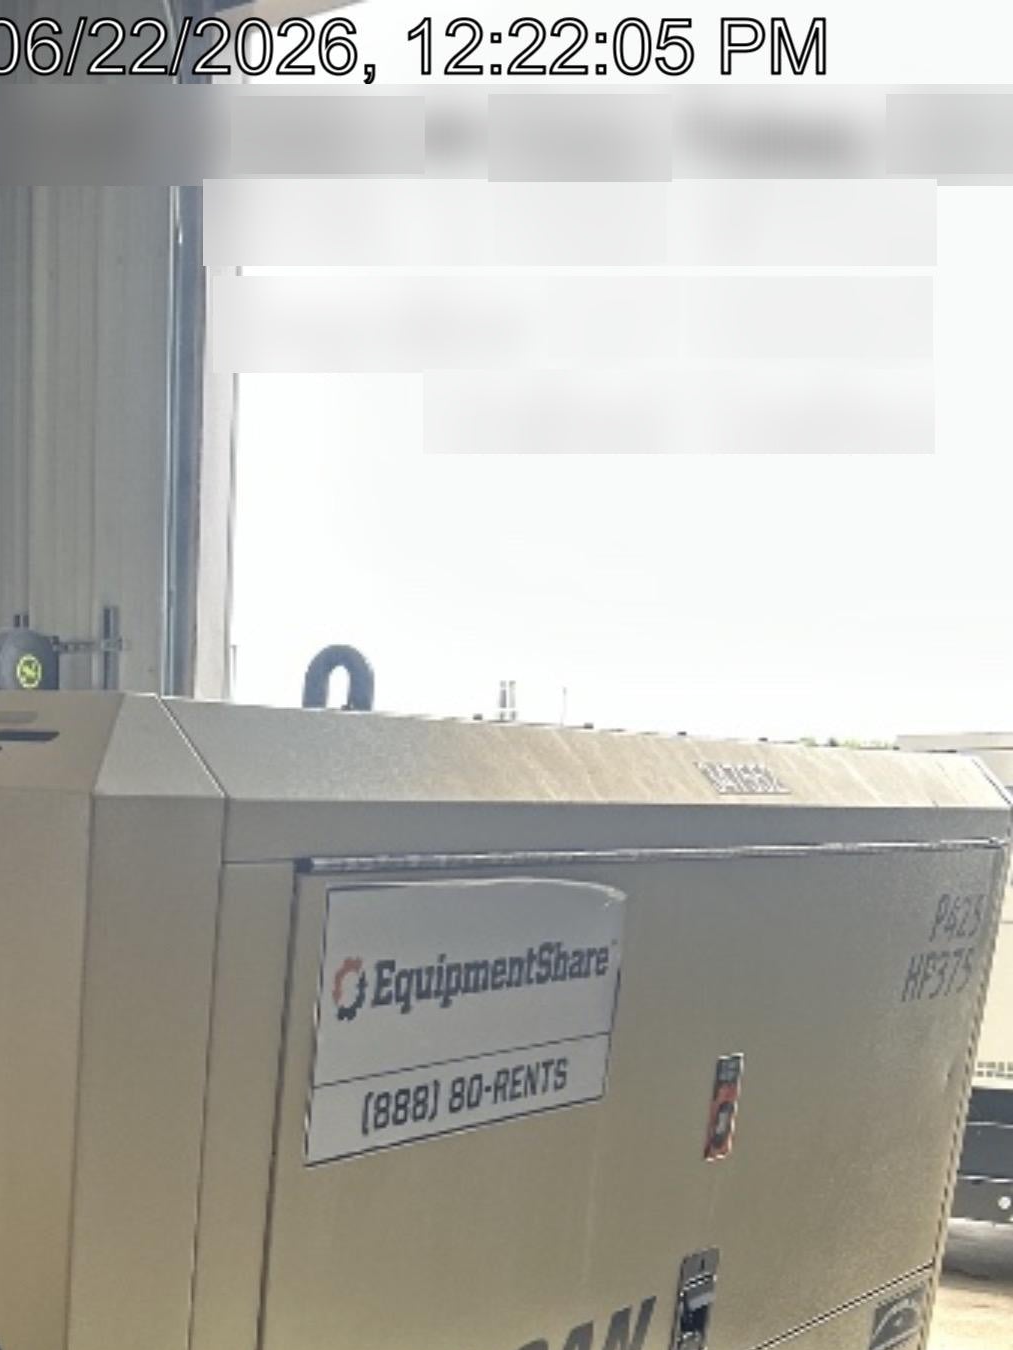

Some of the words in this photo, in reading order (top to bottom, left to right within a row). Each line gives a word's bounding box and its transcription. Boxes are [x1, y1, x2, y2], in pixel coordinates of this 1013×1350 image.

[371, 940, 611, 1015] EquipmentShare
[361, 1078, 441, 1136] (888)
[447, 1057, 569, 1115] 80-RENTS
